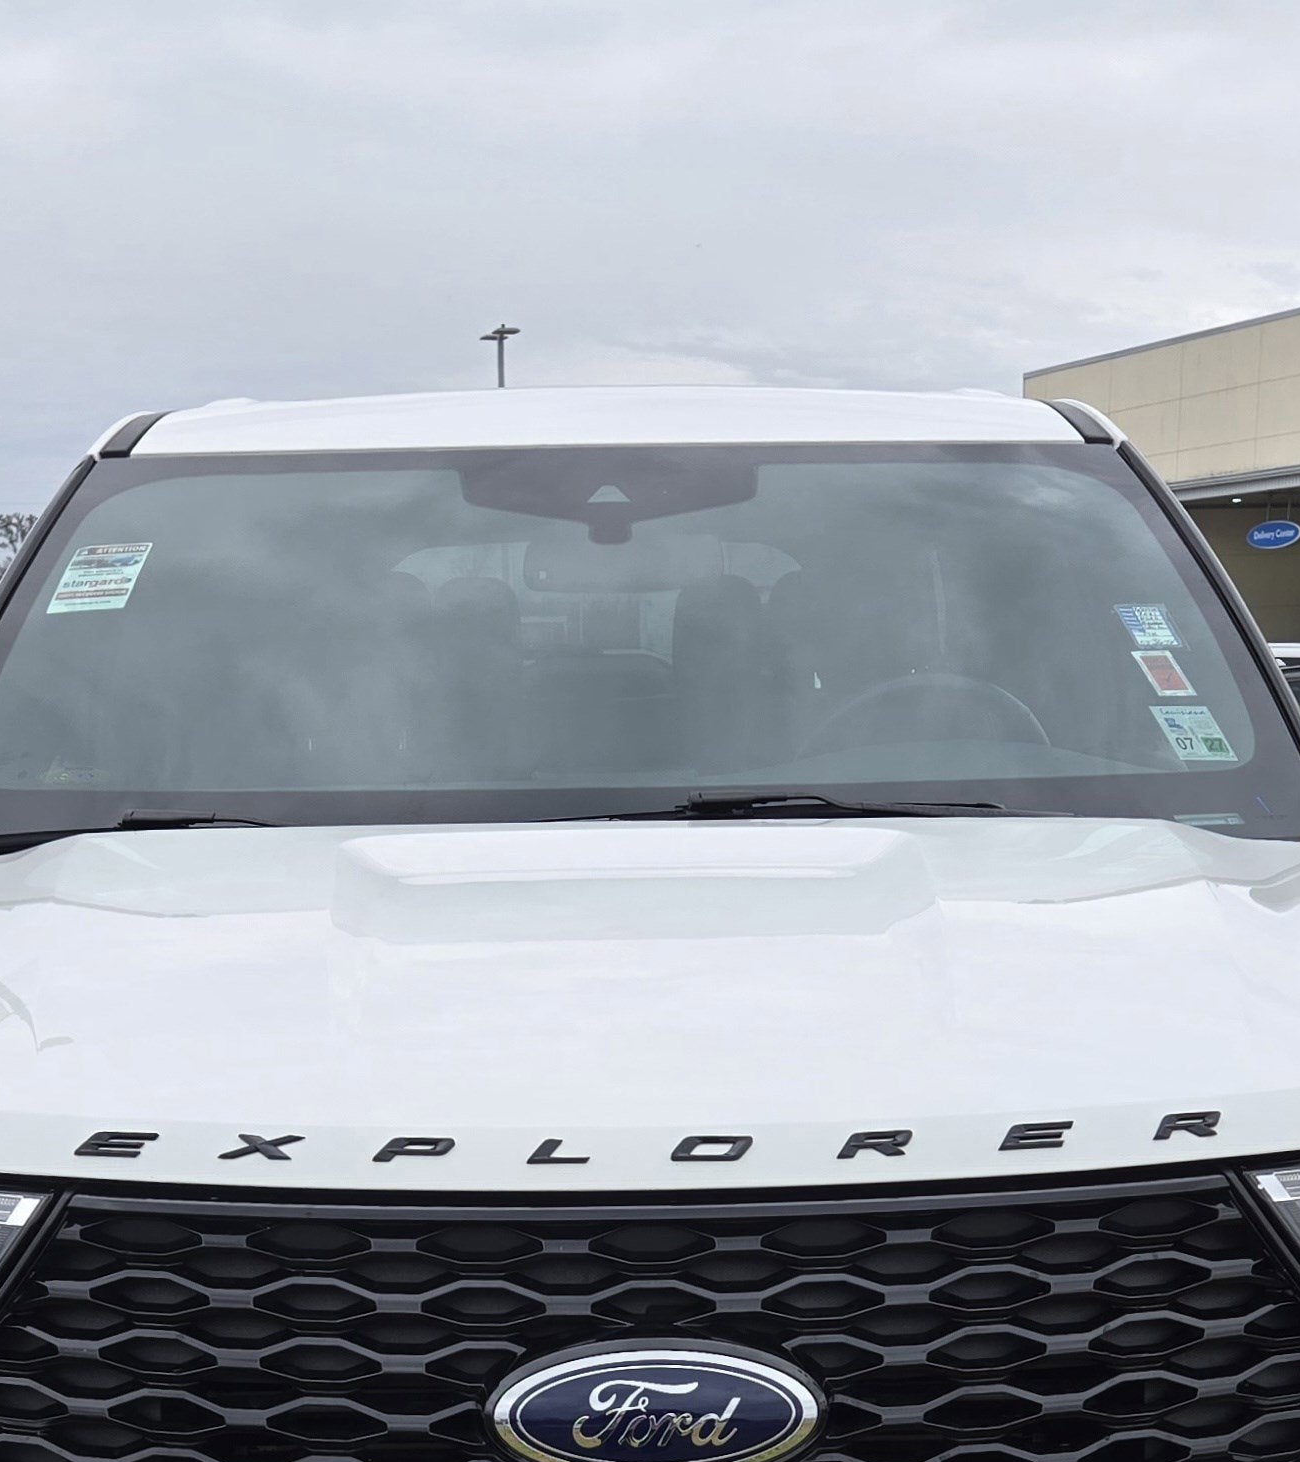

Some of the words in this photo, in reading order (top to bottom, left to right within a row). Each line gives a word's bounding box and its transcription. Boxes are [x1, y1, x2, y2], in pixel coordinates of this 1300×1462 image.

[1275, 528, 1295, 538] Center
[1175, 737, 1194, 751] 07
[74, 1110, 1221, 1166] EXPLORER
[572, 1379, 741, 1449] Ford
